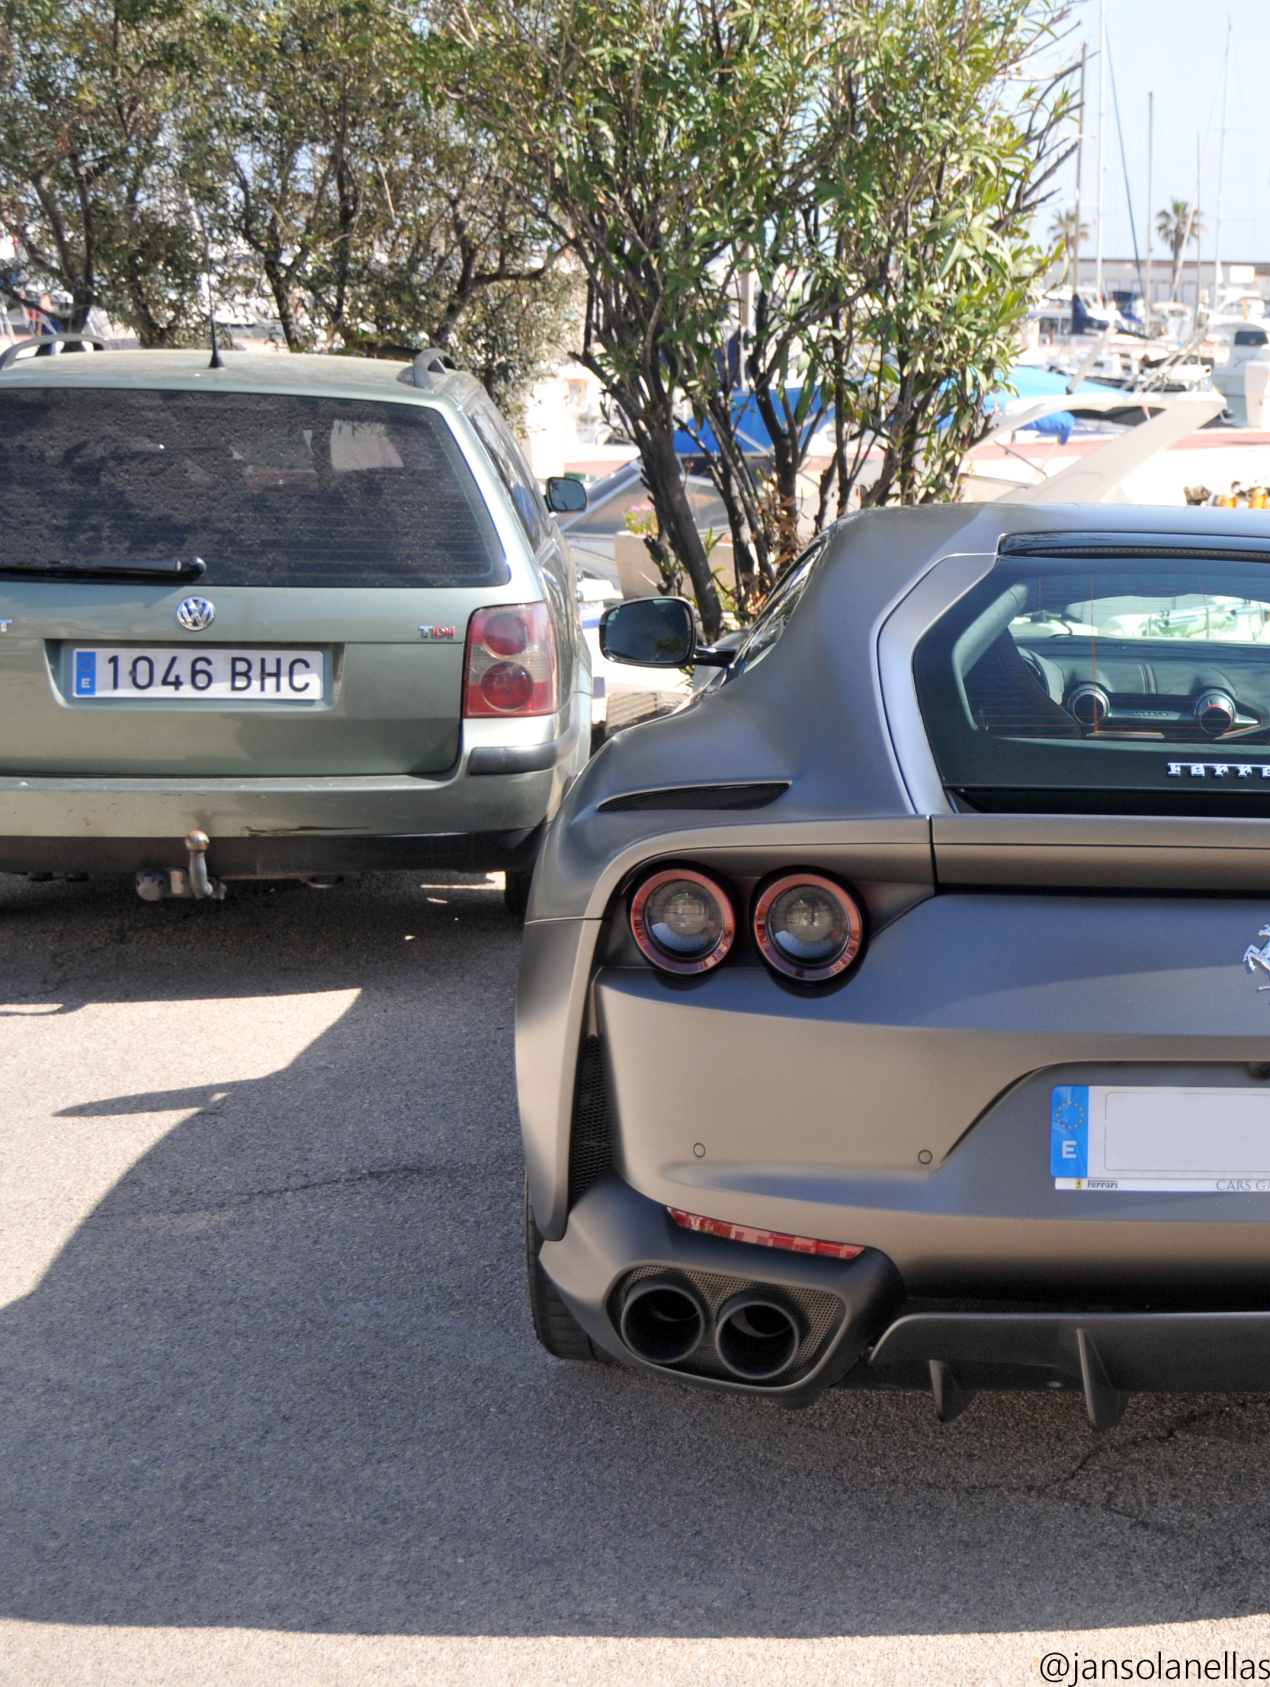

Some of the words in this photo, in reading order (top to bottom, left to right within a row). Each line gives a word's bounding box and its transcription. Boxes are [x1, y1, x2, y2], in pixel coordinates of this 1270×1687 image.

[419, 625, 454, 638] TDI
[109, 655, 213, 691] 1046
[230, 656, 311, 692] BHC
[81, 678, 91, 689] E
[1062, 1141, 1077, 1158] E
[1087, 1180, 1118, 1189] Ferrari
[1216, 1180, 1251, 1191] CARS
